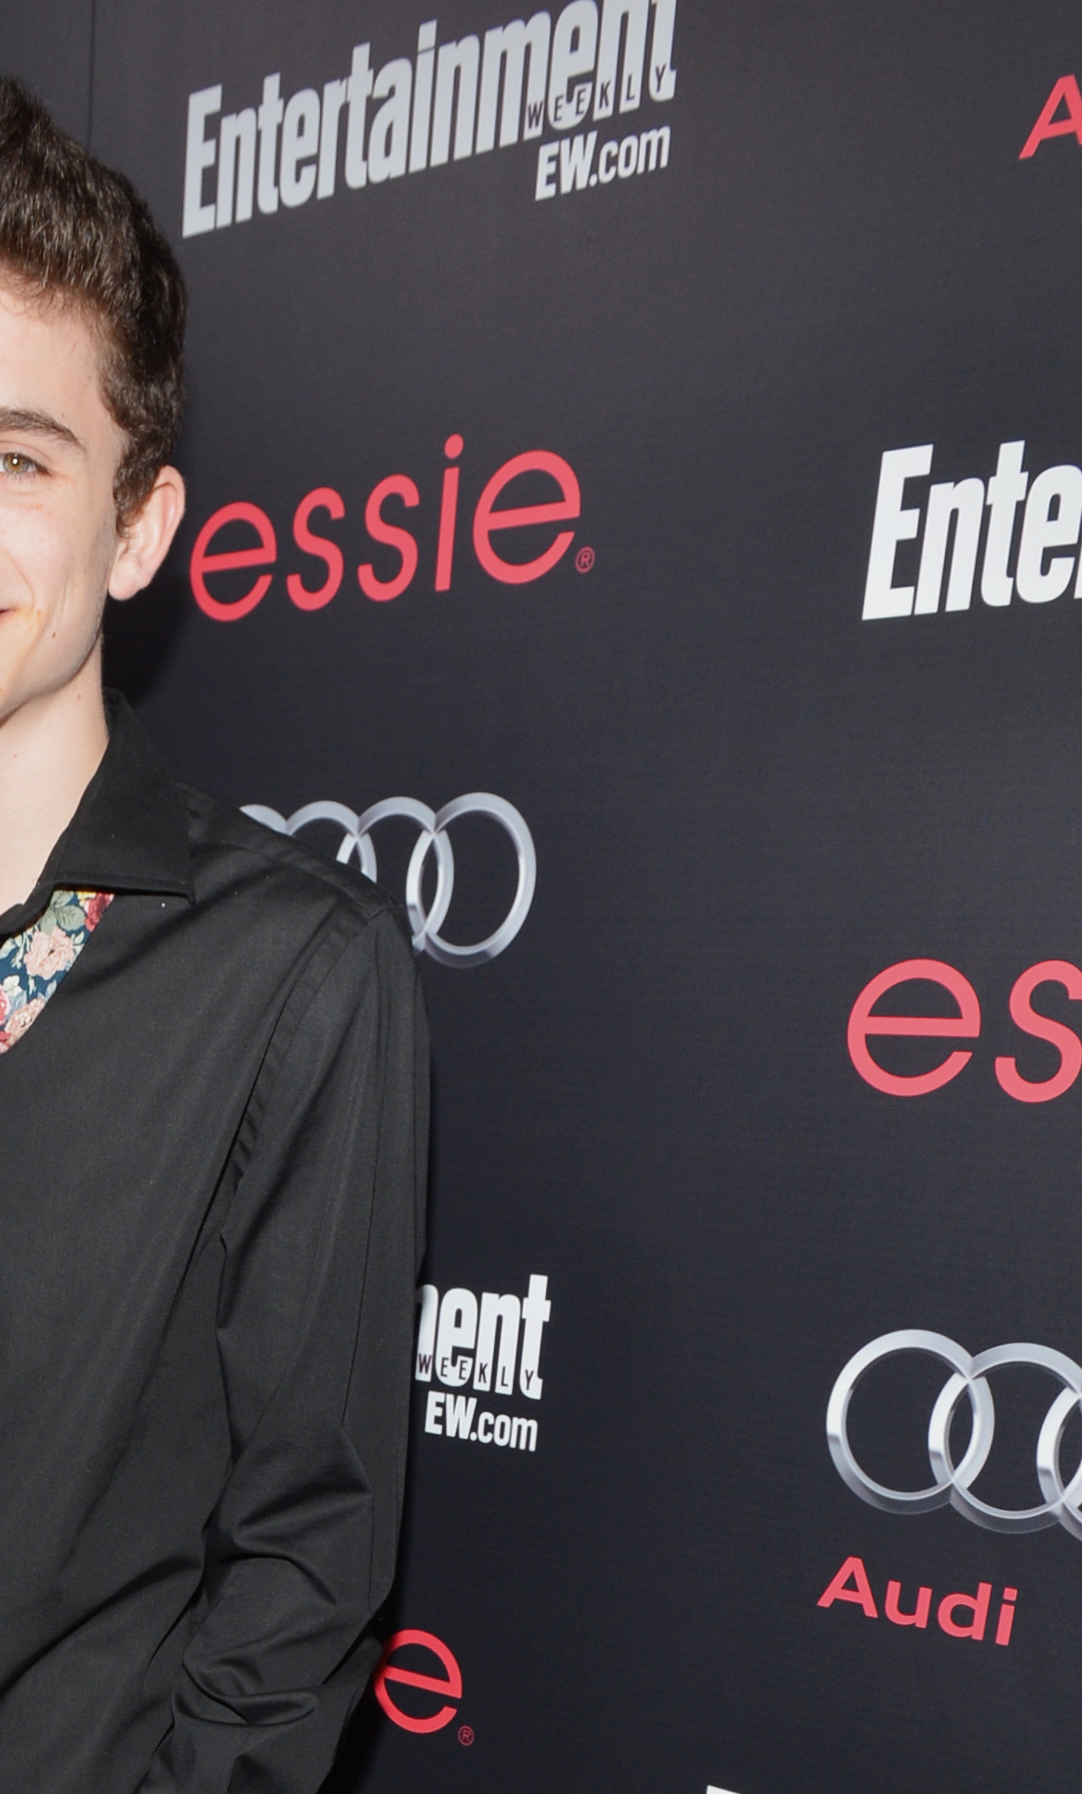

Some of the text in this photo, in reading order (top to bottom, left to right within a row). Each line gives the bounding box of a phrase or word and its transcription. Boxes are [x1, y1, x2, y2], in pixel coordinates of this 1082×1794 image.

[182, 0, 676, 238] Entertainment
[535, 125, 671, 201] EW.com
[191, 433, 581, 621] essie
[862, 440, 1082, 620] Ente
[417, 1352, 535, 1392] WEEKLY
[424, 1390, 538, 1452] EW.com
[817, 1555, 1018, 1646] Audi
